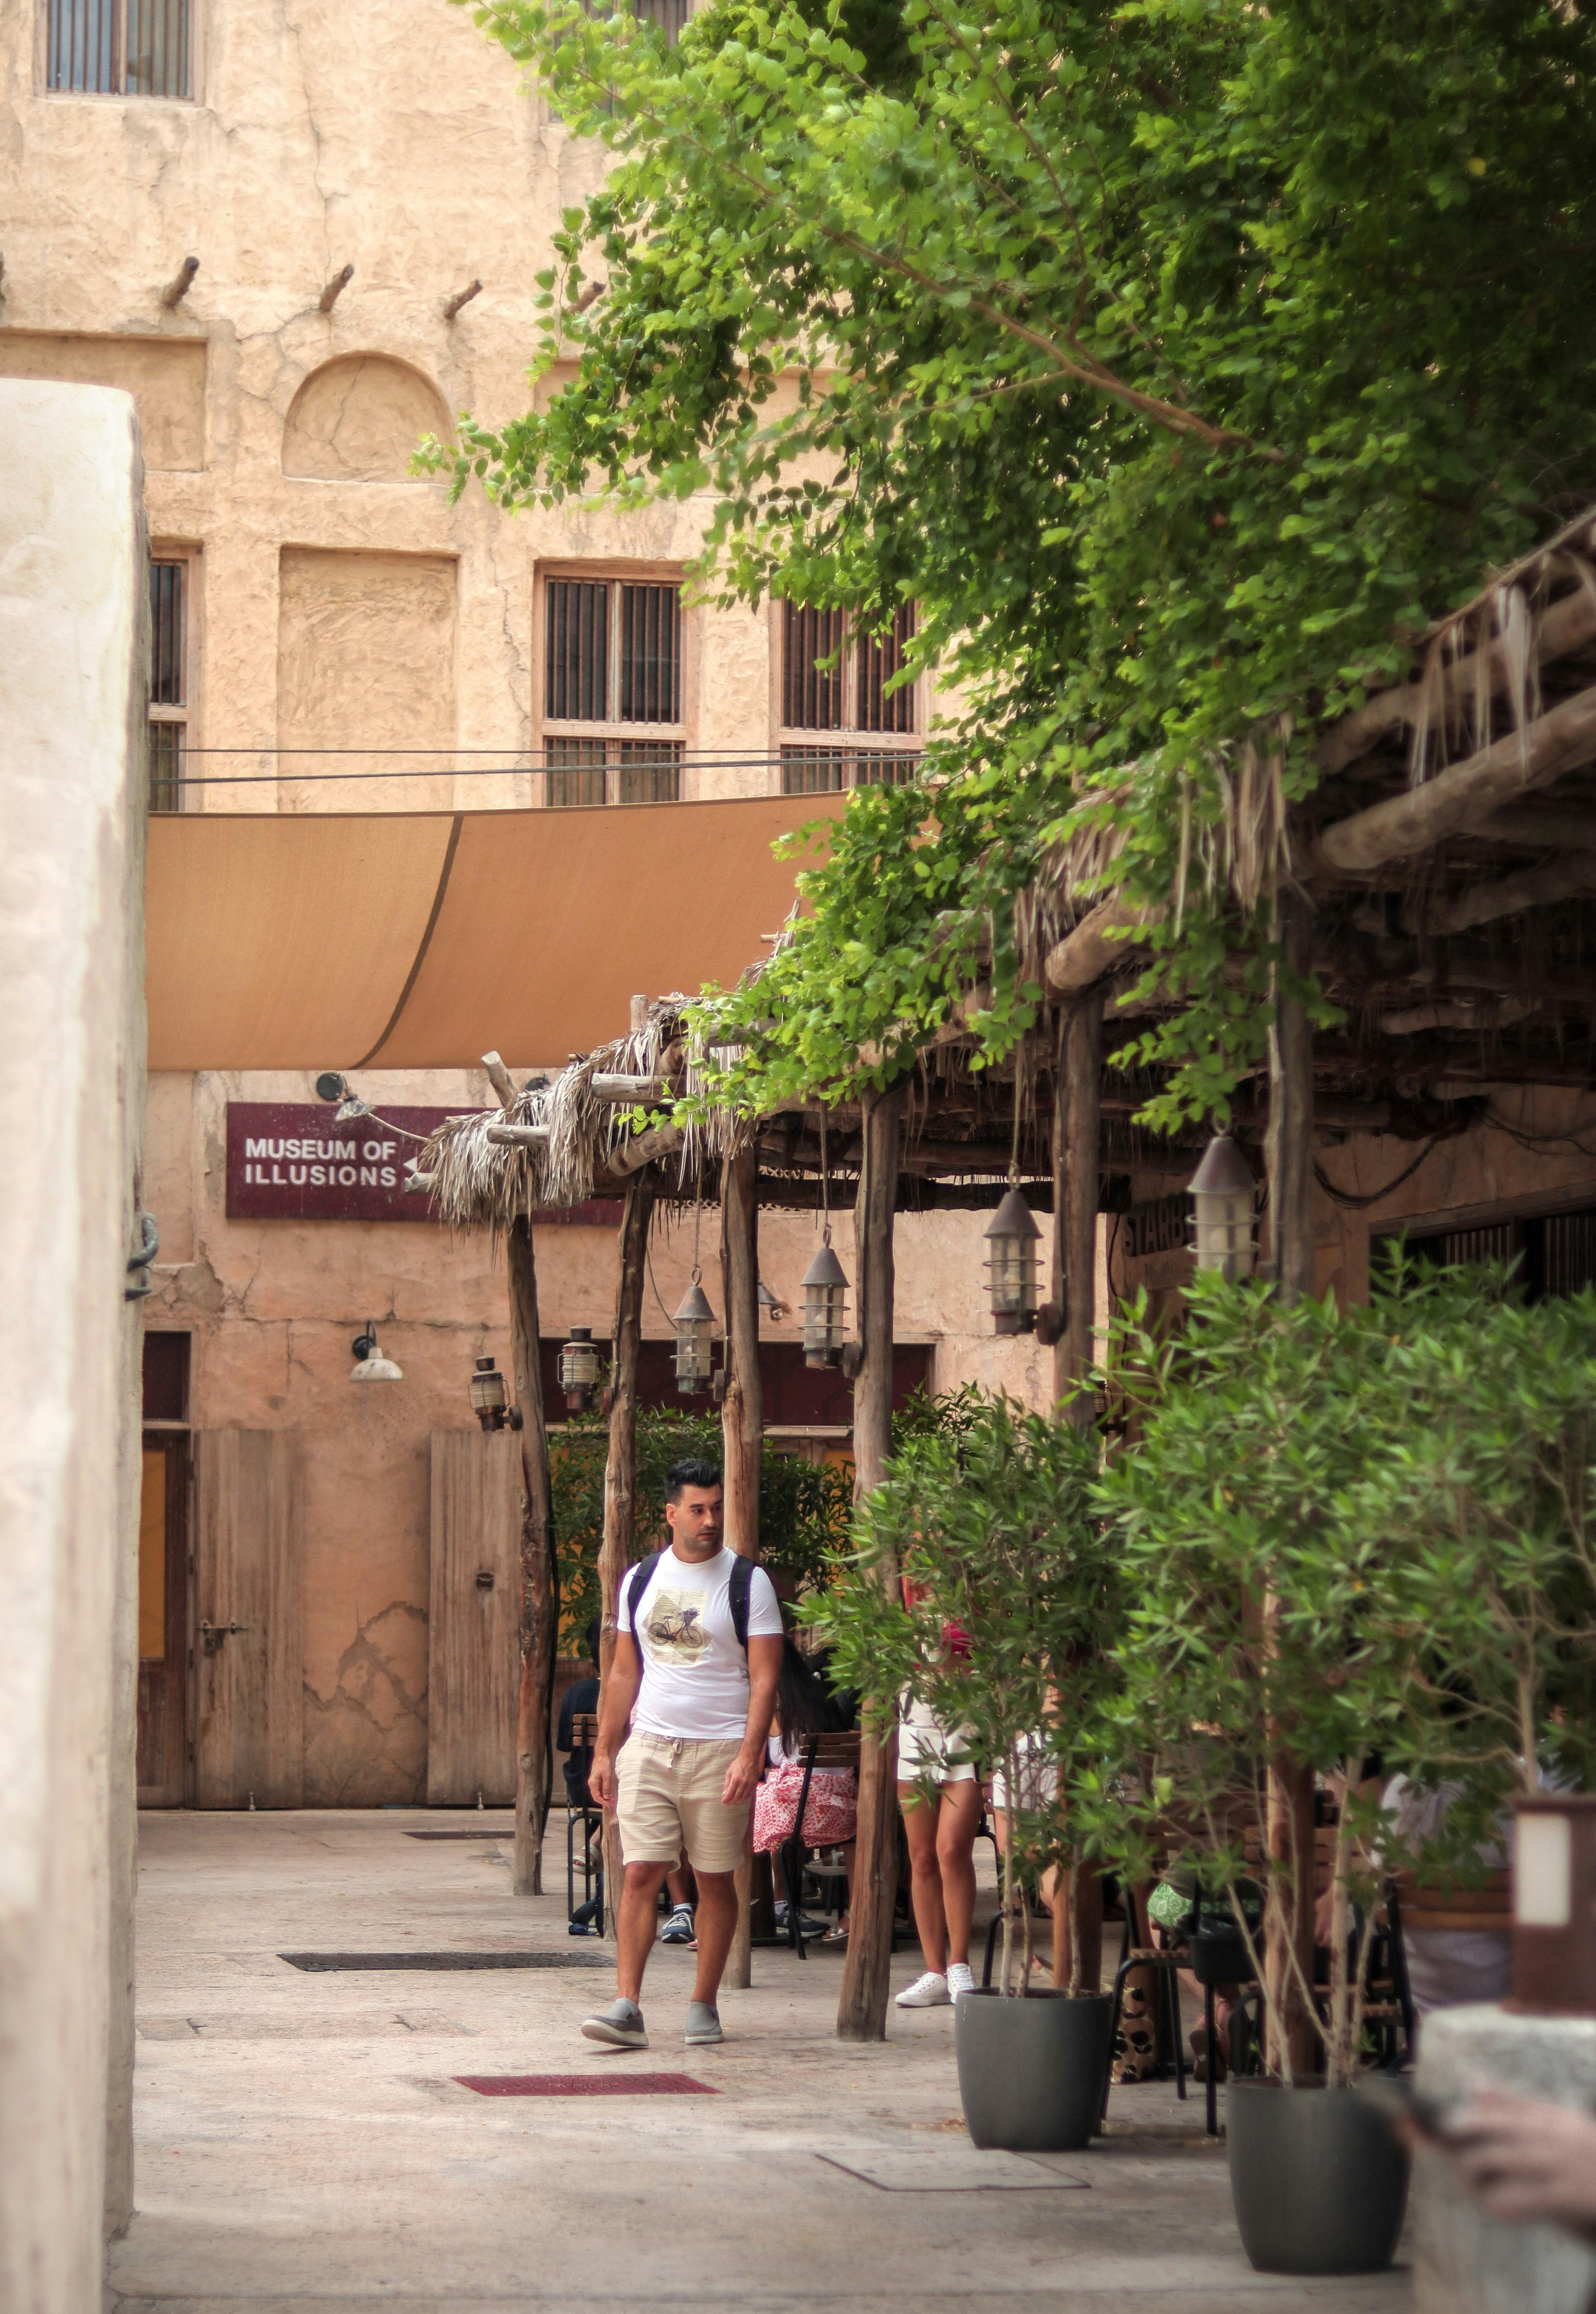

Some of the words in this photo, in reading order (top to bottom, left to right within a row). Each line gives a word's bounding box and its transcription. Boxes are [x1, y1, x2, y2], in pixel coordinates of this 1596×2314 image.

[245, 1138, 356, 1160] MUSEUM
[363, 1140, 396, 1161] OF
[245, 1164, 396, 1187] ILLUSIONS
